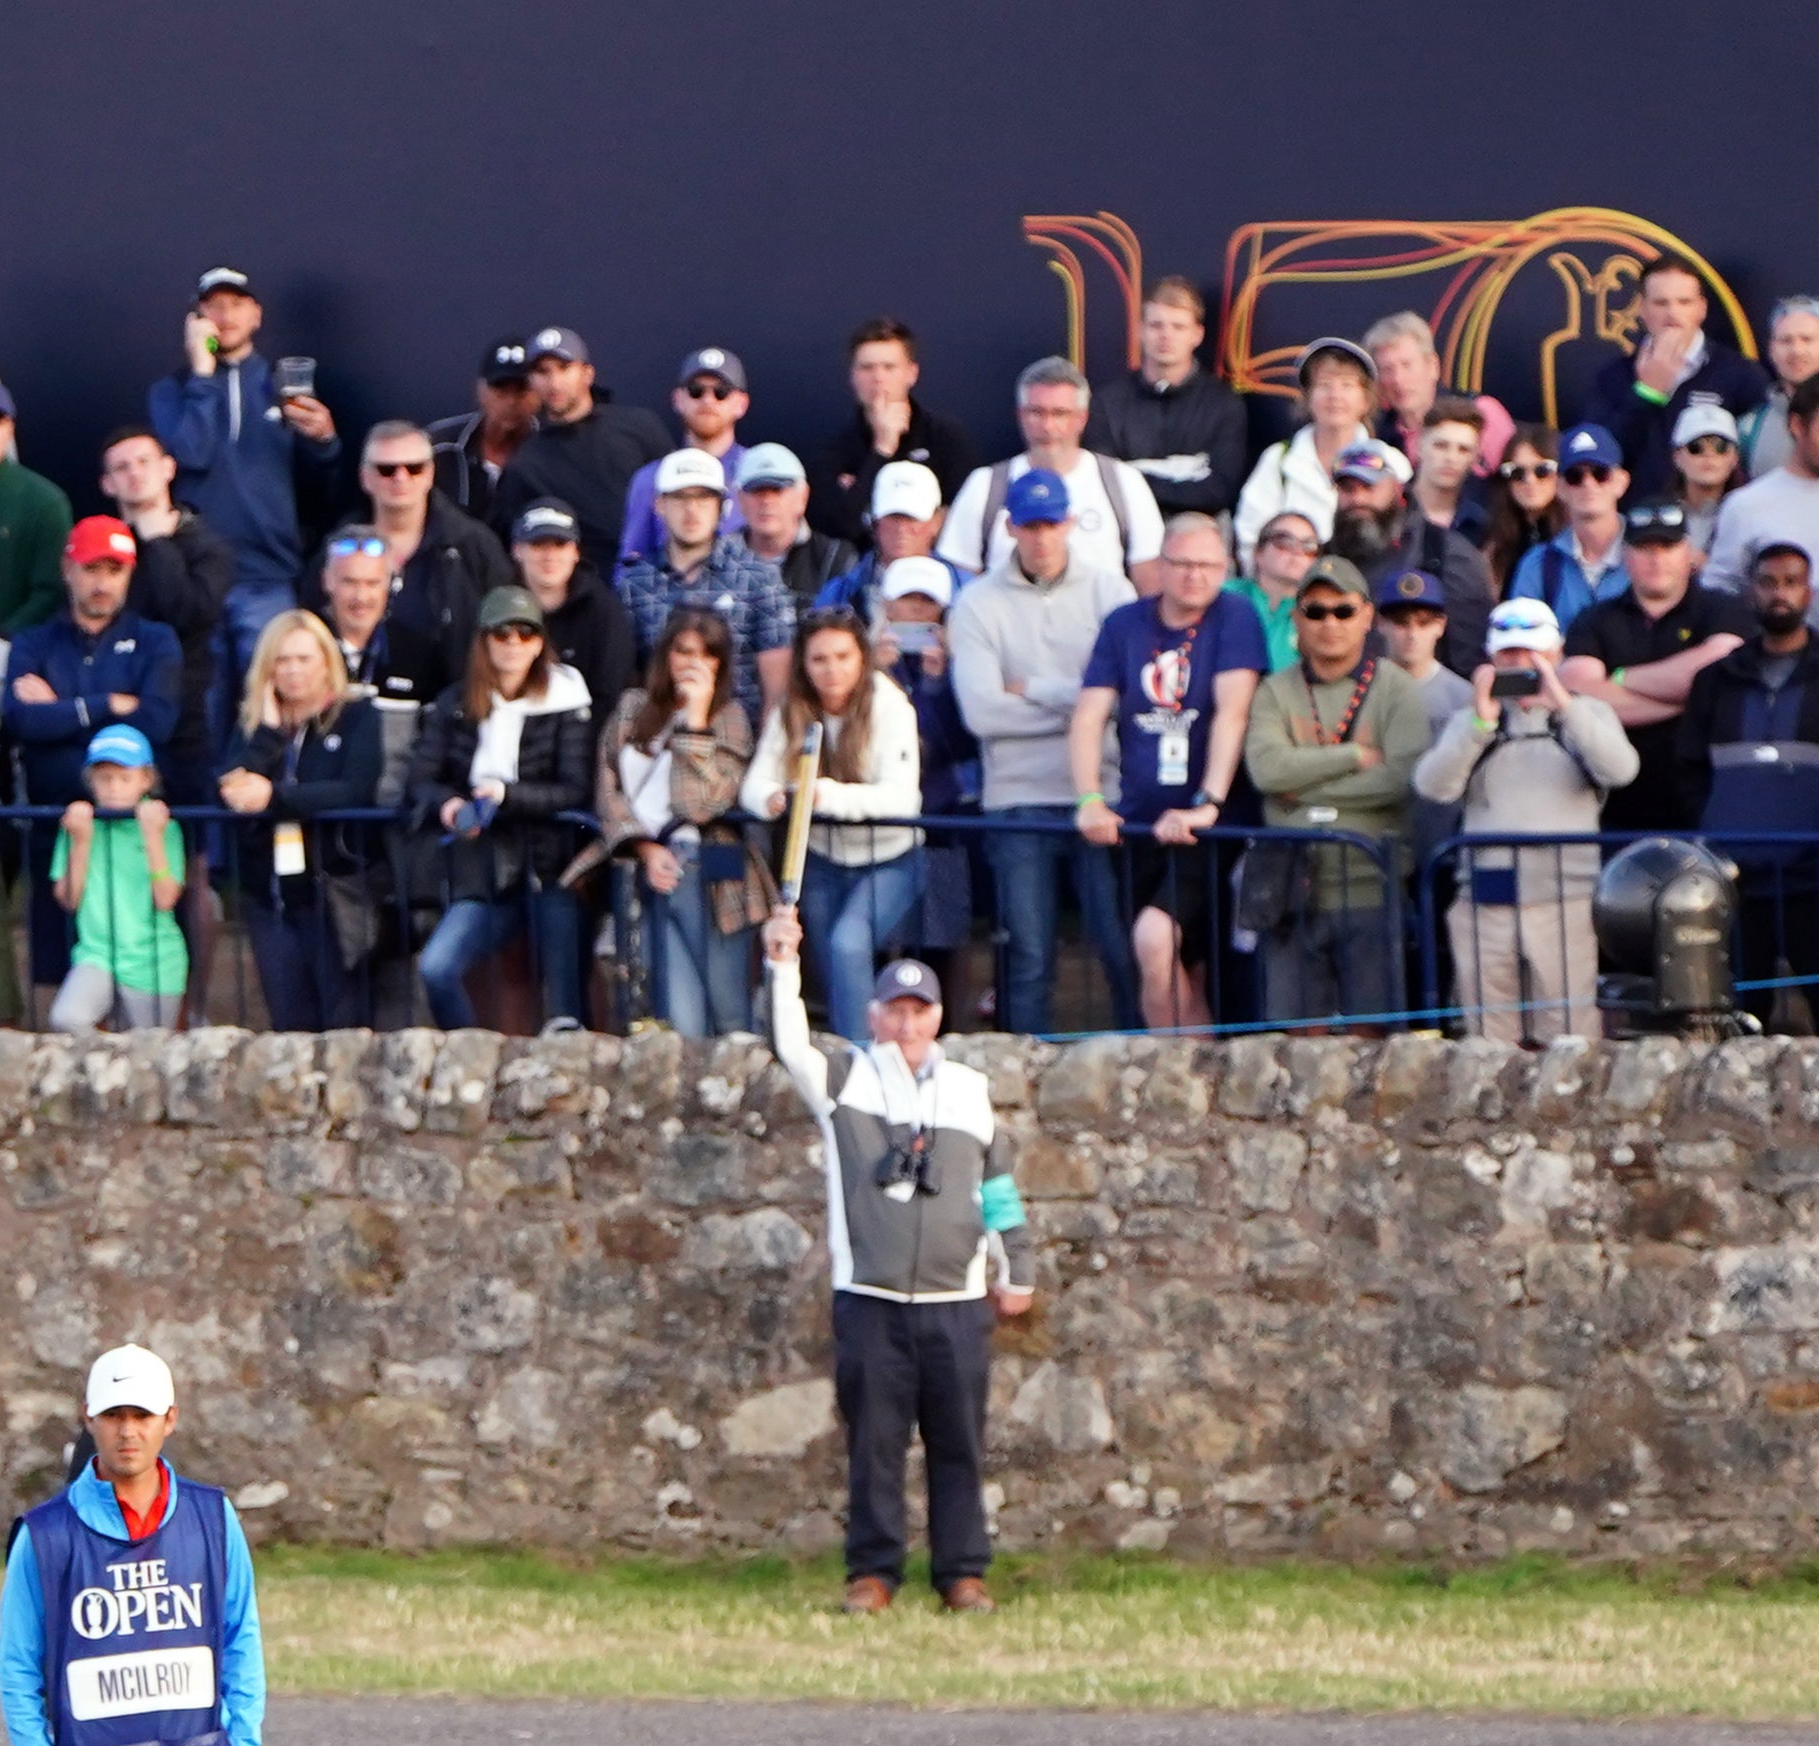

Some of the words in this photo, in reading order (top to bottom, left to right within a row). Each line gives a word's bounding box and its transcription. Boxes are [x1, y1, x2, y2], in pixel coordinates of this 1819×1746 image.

[106, 1559, 169, 1591] THE
[71, 1583, 203, 1640] OPEN
[98, 1661, 192, 1704] MCILROY
